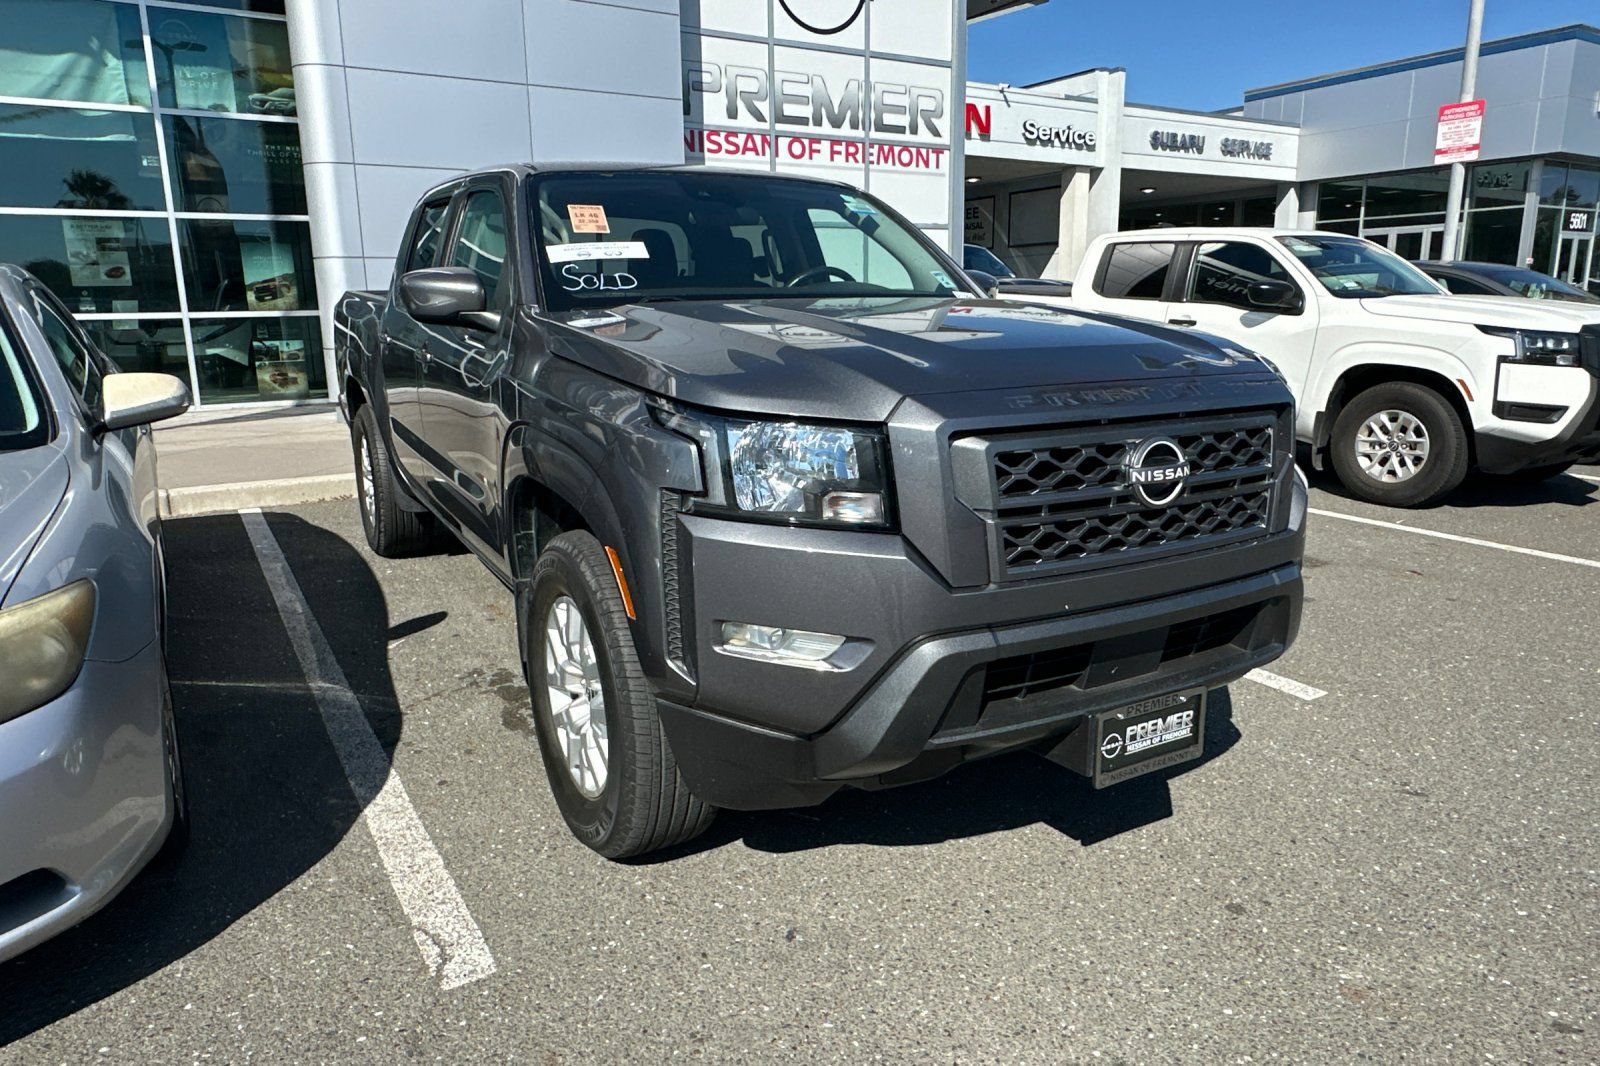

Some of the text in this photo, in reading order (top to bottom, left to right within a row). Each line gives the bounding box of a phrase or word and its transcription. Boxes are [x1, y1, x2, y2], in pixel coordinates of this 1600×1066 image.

[681, 62, 944, 138] PREMIER
[1023, 119, 1096, 148] Service
[1150, 130, 1273, 159] SUBARU SERVICE
[683, 129, 944, 169] NISSAN OF FREMONT
[562, 263, 638, 291] SOLD
[1132, 466, 1190, 482] NISSAN
[1126, 694, 1180, 715] PREMIER
[1125, 709, 1194, 743] PREMIER
[1126, 728, 1192, 752] NISSAN OF FREMONT
